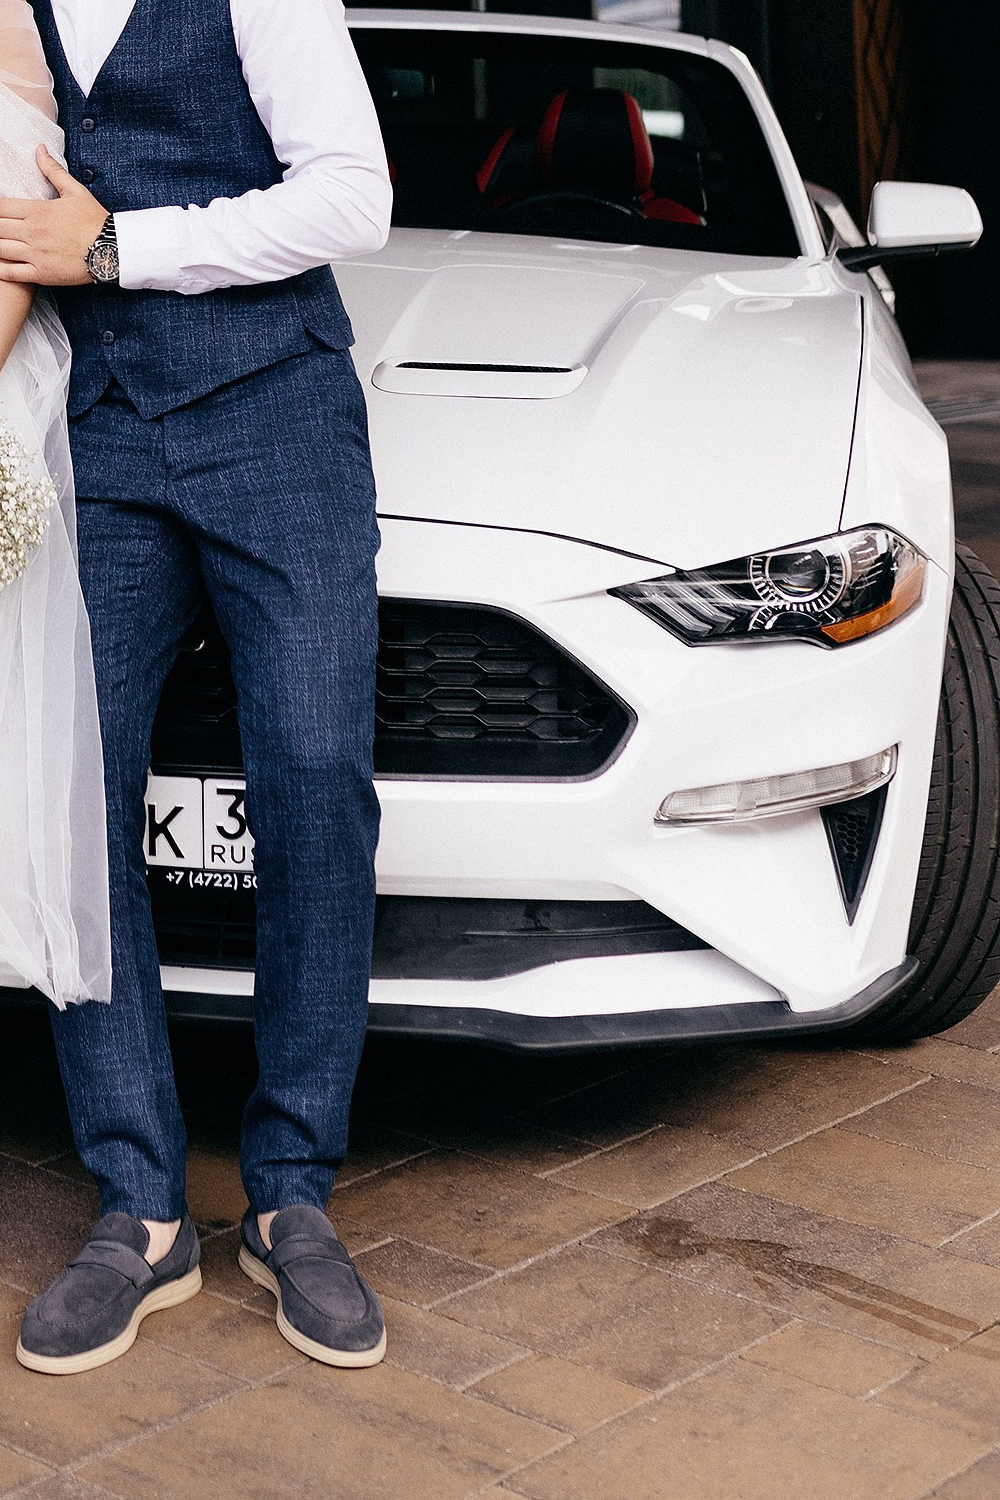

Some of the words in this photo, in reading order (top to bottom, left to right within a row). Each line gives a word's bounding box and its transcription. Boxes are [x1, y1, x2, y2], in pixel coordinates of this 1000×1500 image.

[147, 803, 185, 859] K
[211, 844, 255, 864] RU
[166, 870, 185, 885] +7
[188, 870, 238, 891] (4722)
